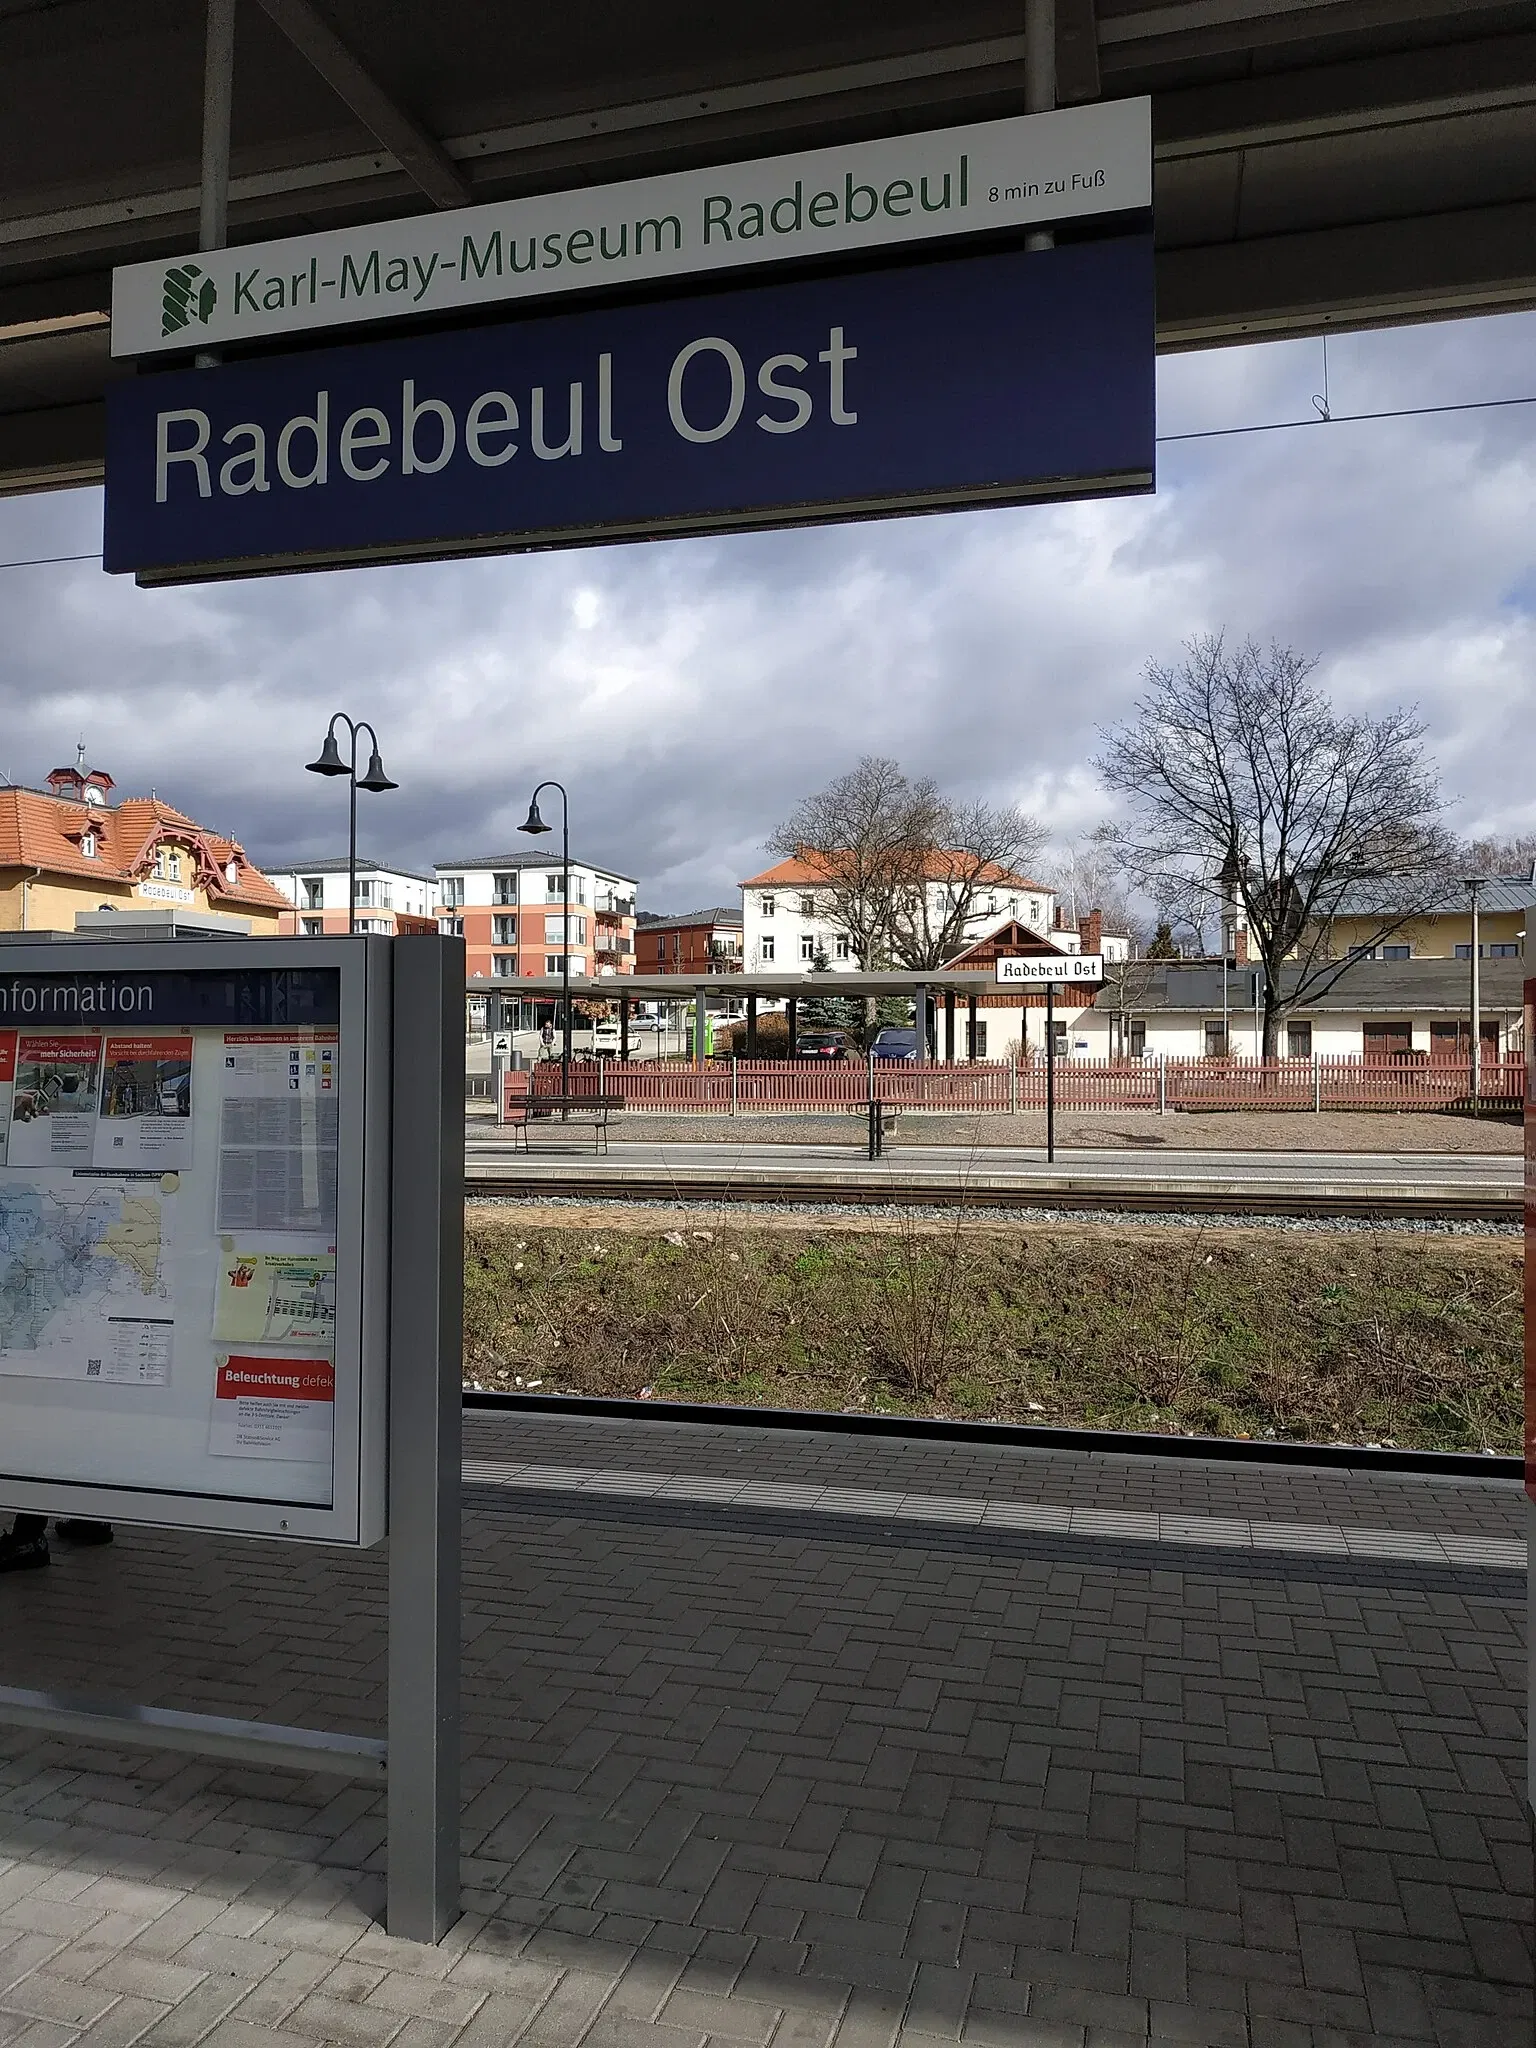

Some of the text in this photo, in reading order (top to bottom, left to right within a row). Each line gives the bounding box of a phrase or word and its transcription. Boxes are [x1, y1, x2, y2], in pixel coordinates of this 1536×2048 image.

[988, 169, 1106, 203] 8 min zu Fuß
[234, 154, 968, 315] Karl-May-Museum Radebeul
[155, 326, 858, 503] Radebeul Ost
[1003, 961, 1096, 977] Radebeul Ost
[40, 1049, 97, 1058] mehr Sicherheit!
[225, 1370, 334, 1388] Beleuchtung defek
